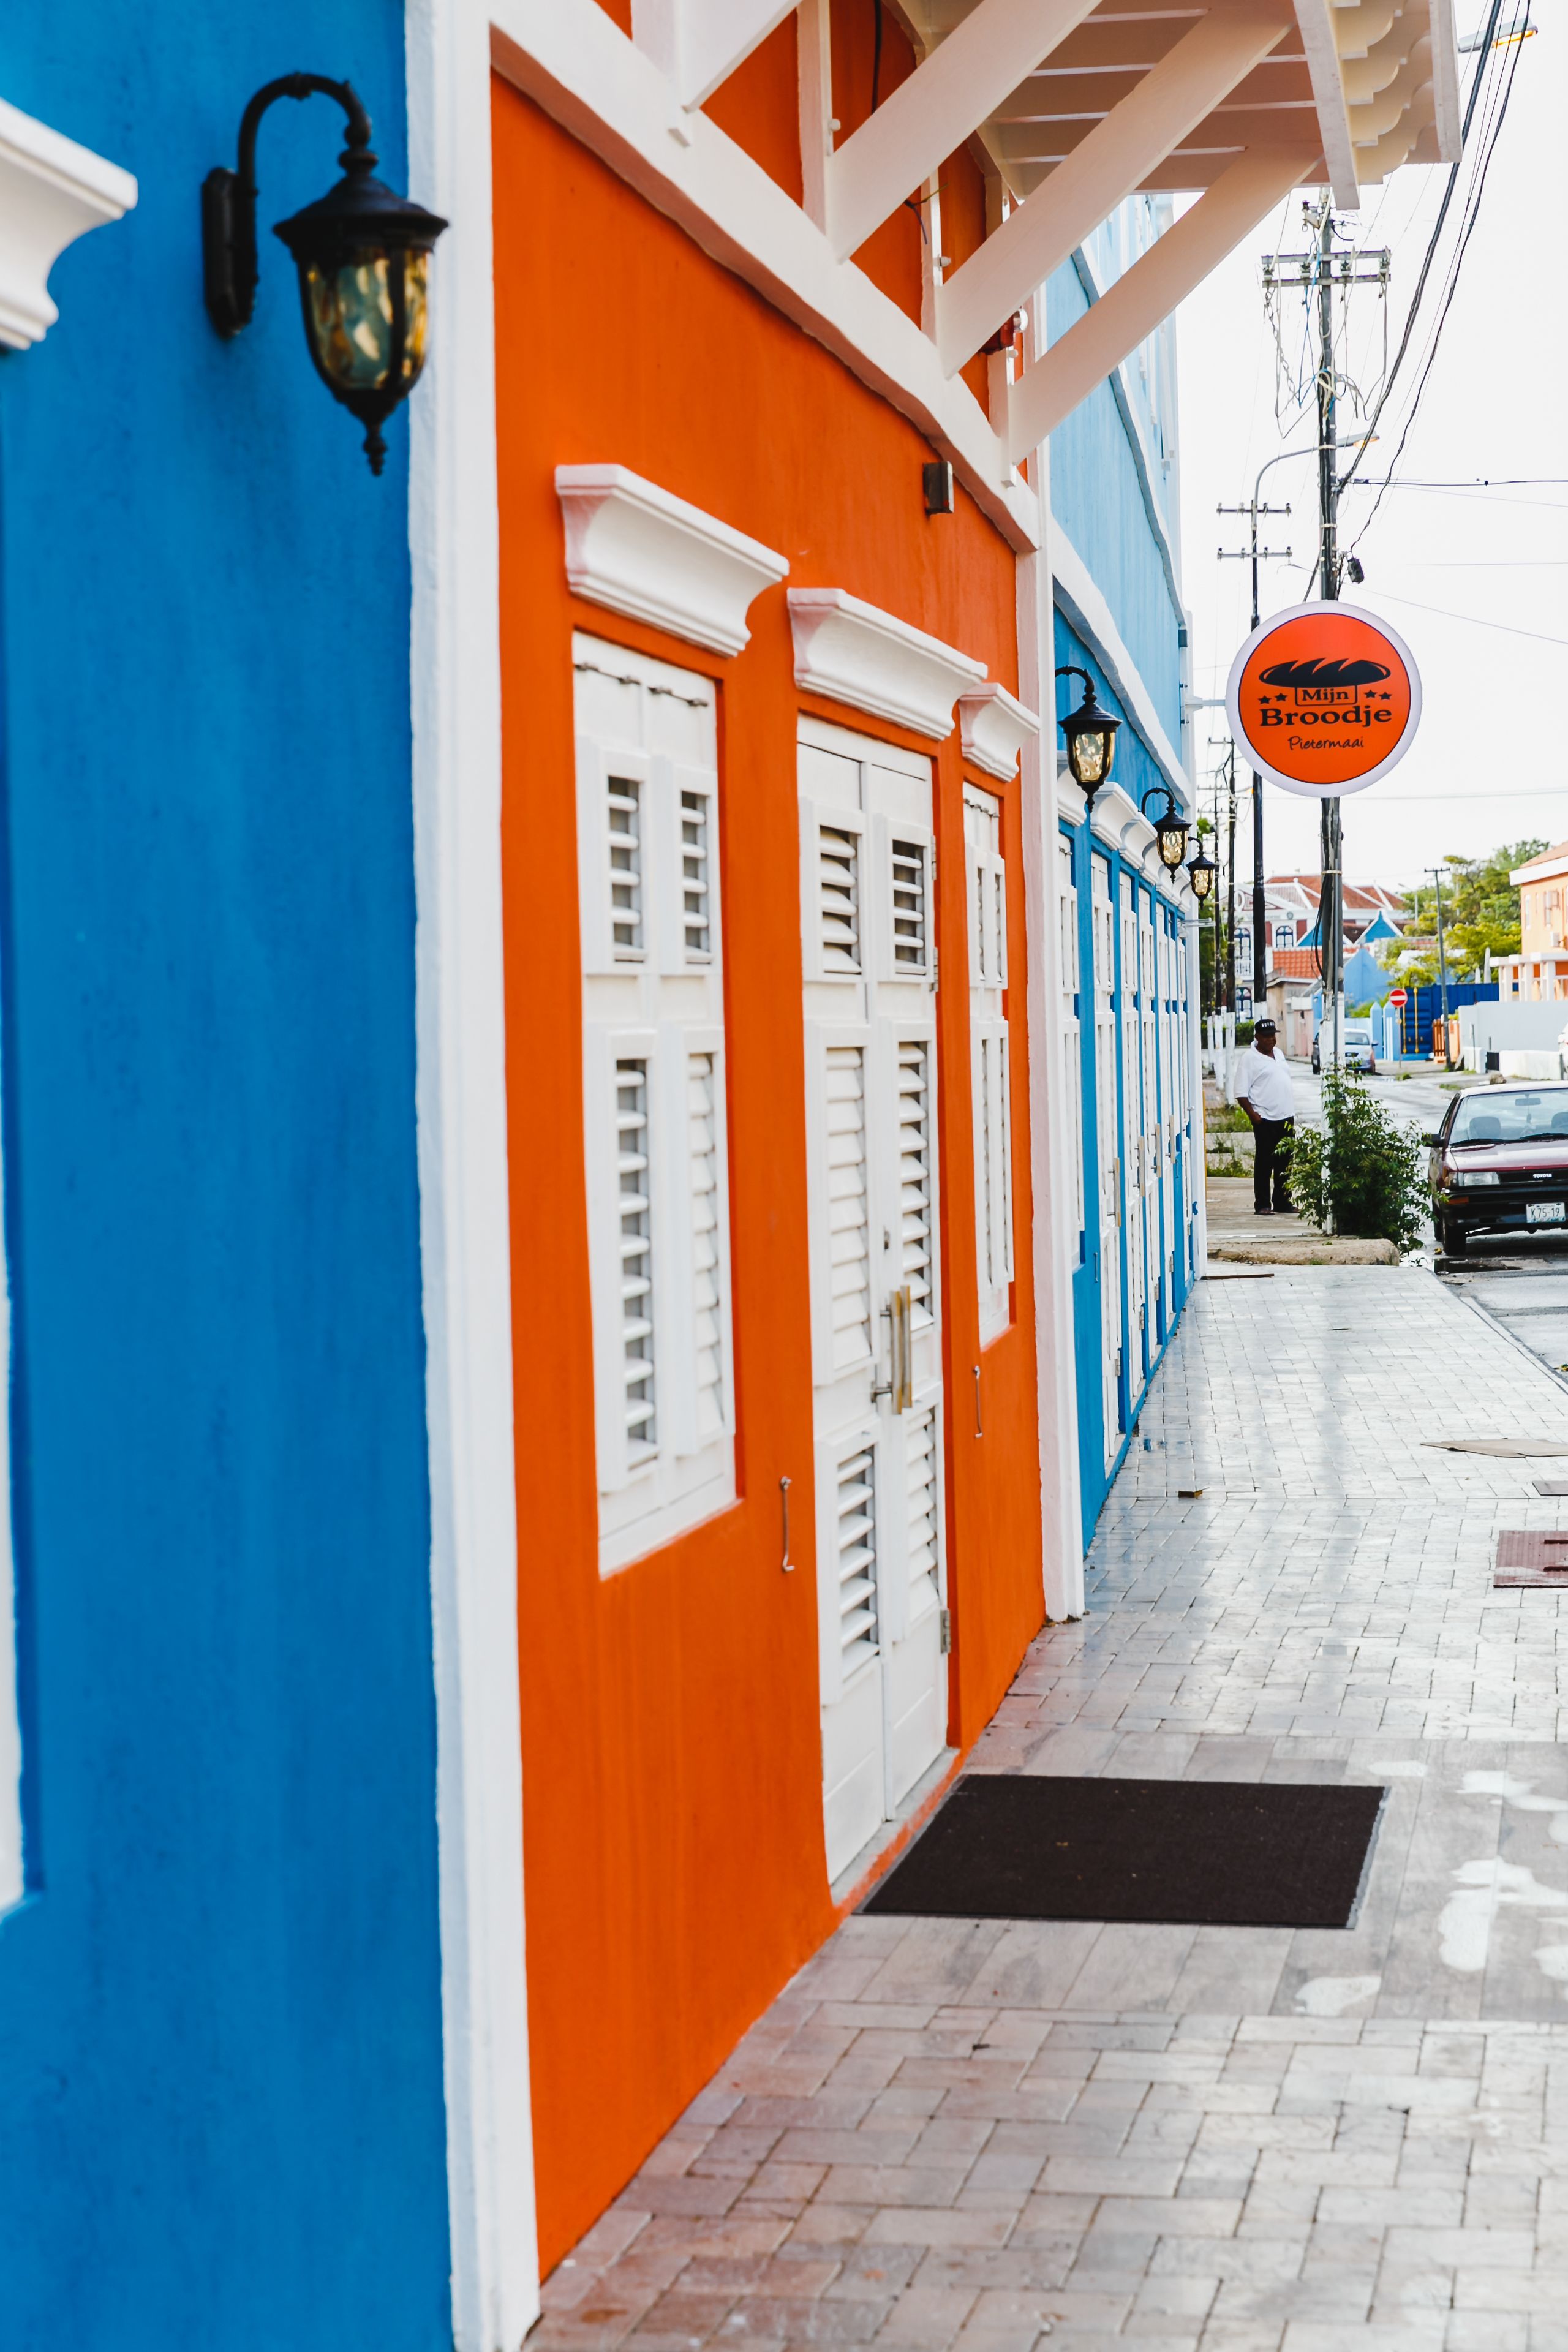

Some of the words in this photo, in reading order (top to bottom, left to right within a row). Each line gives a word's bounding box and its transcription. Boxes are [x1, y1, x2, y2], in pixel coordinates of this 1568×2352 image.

[1302, 688, 1349, 703] Mijn
[1259, 705, 1392, 727] Broodje
[1288, 736, 1365, 750] Pietermaai
